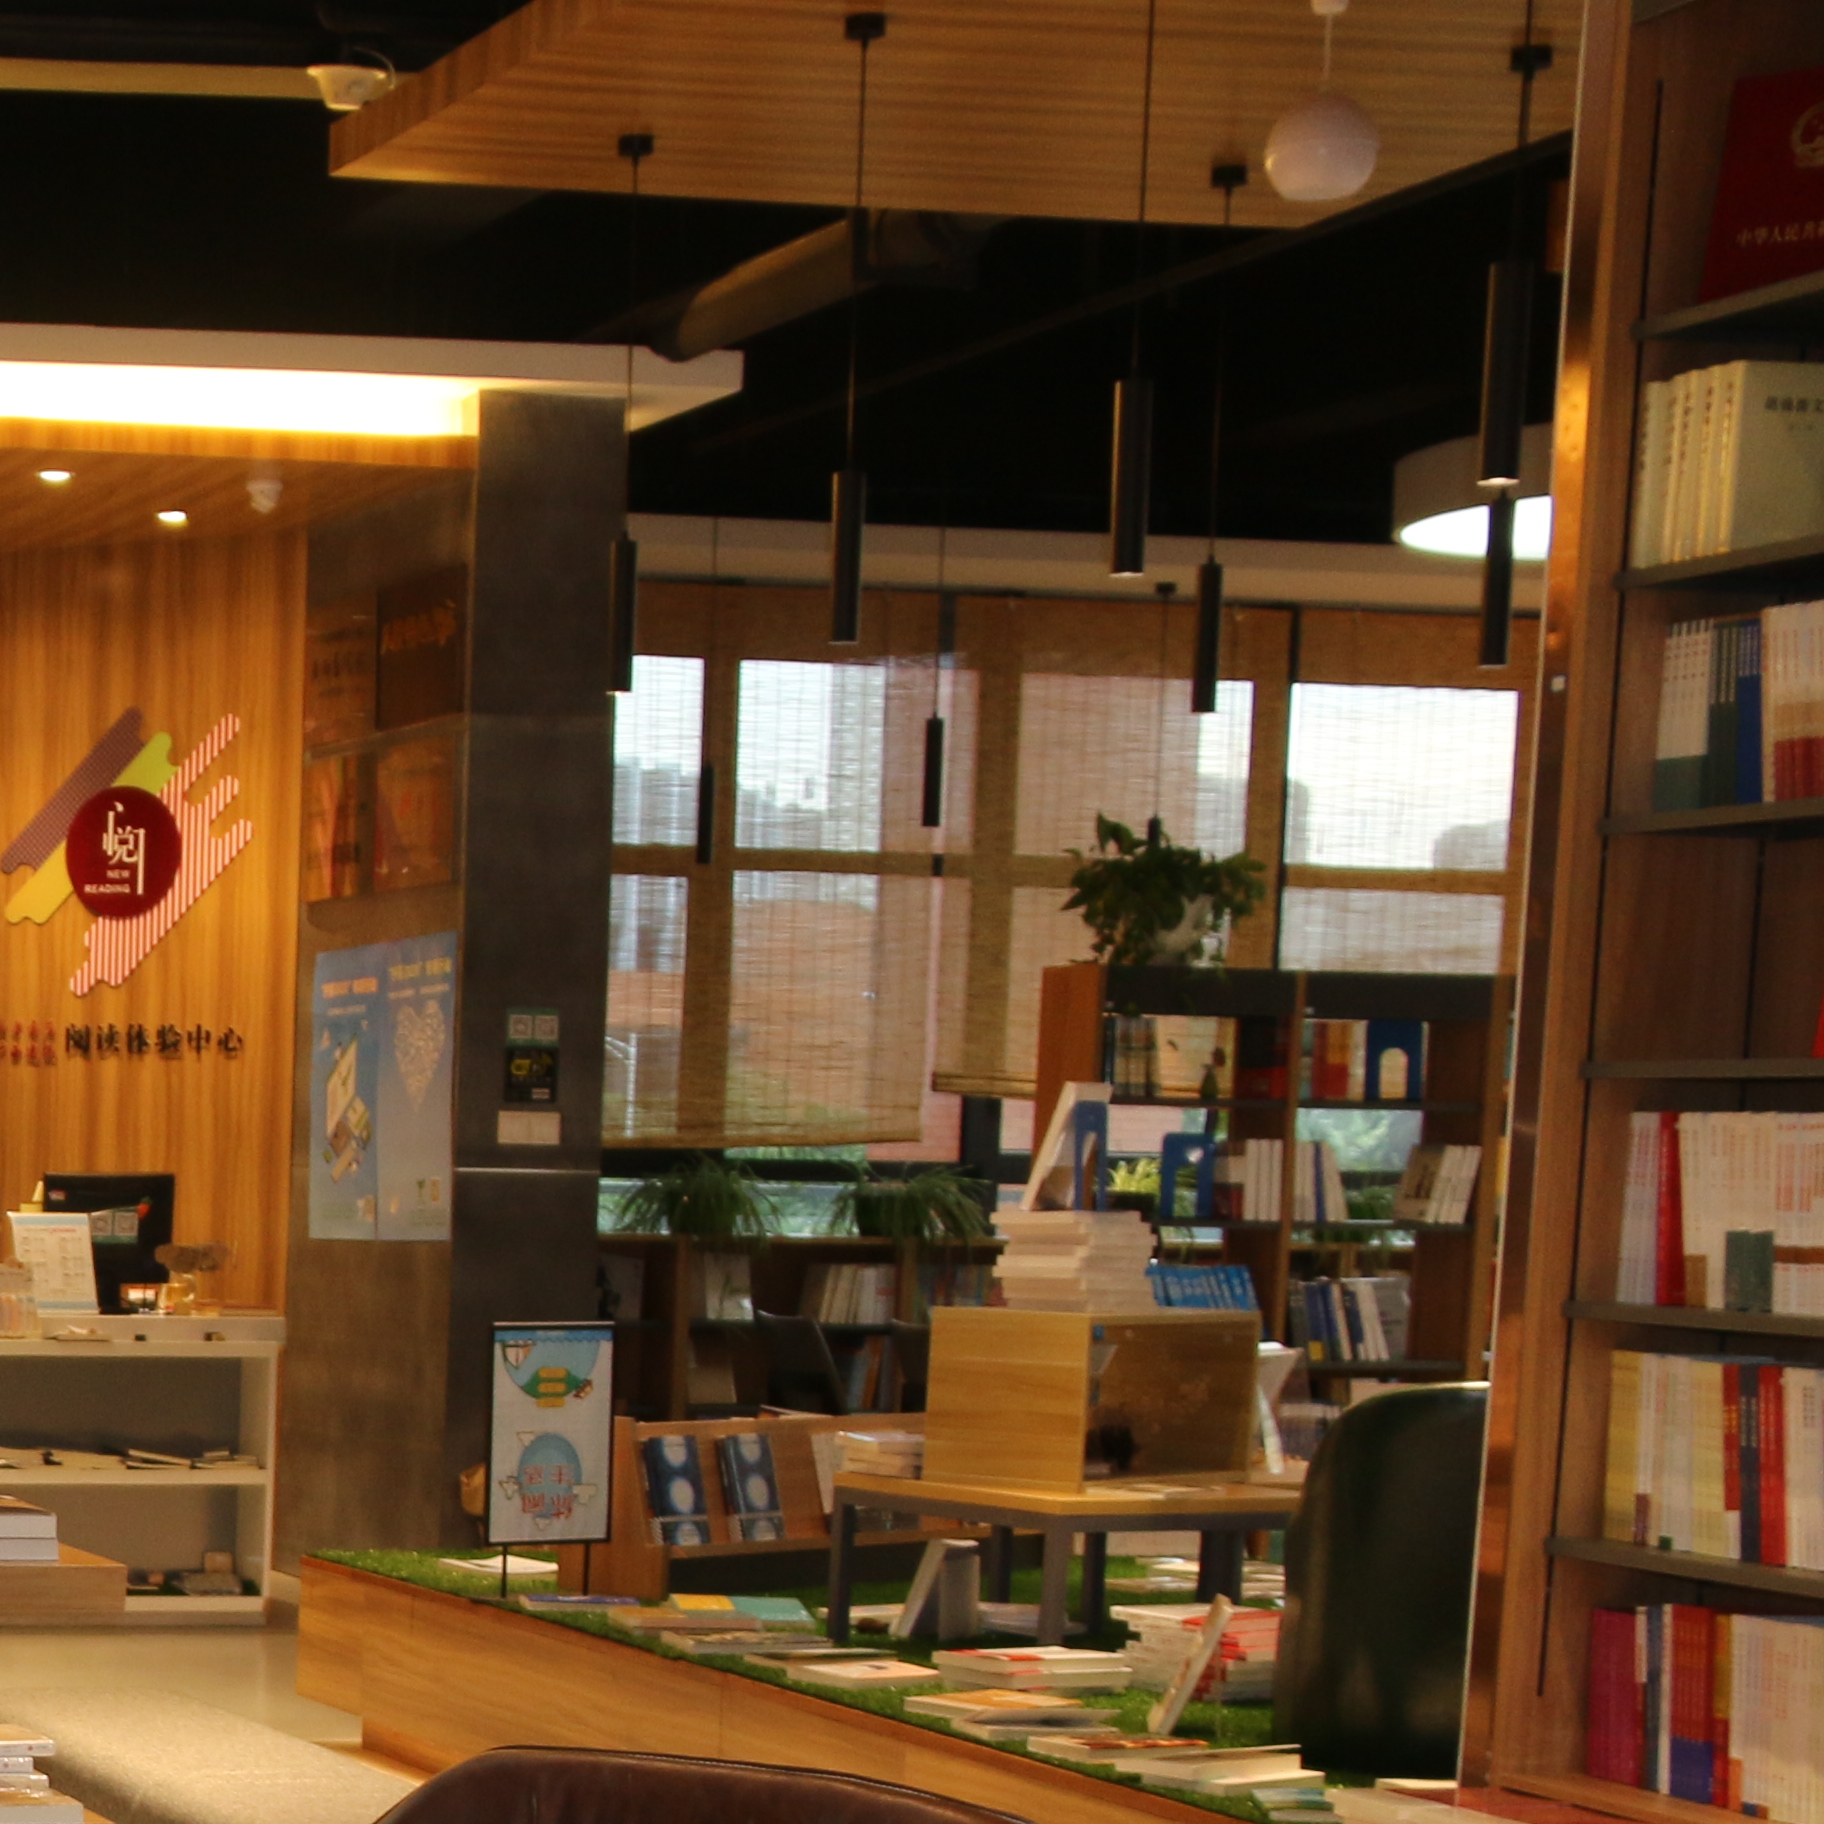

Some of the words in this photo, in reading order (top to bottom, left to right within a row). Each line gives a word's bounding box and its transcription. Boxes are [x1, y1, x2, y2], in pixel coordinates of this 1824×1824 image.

[83, 883, 131, 895] READING
[64, 1021, 244, 1058] 阅读体验中心
